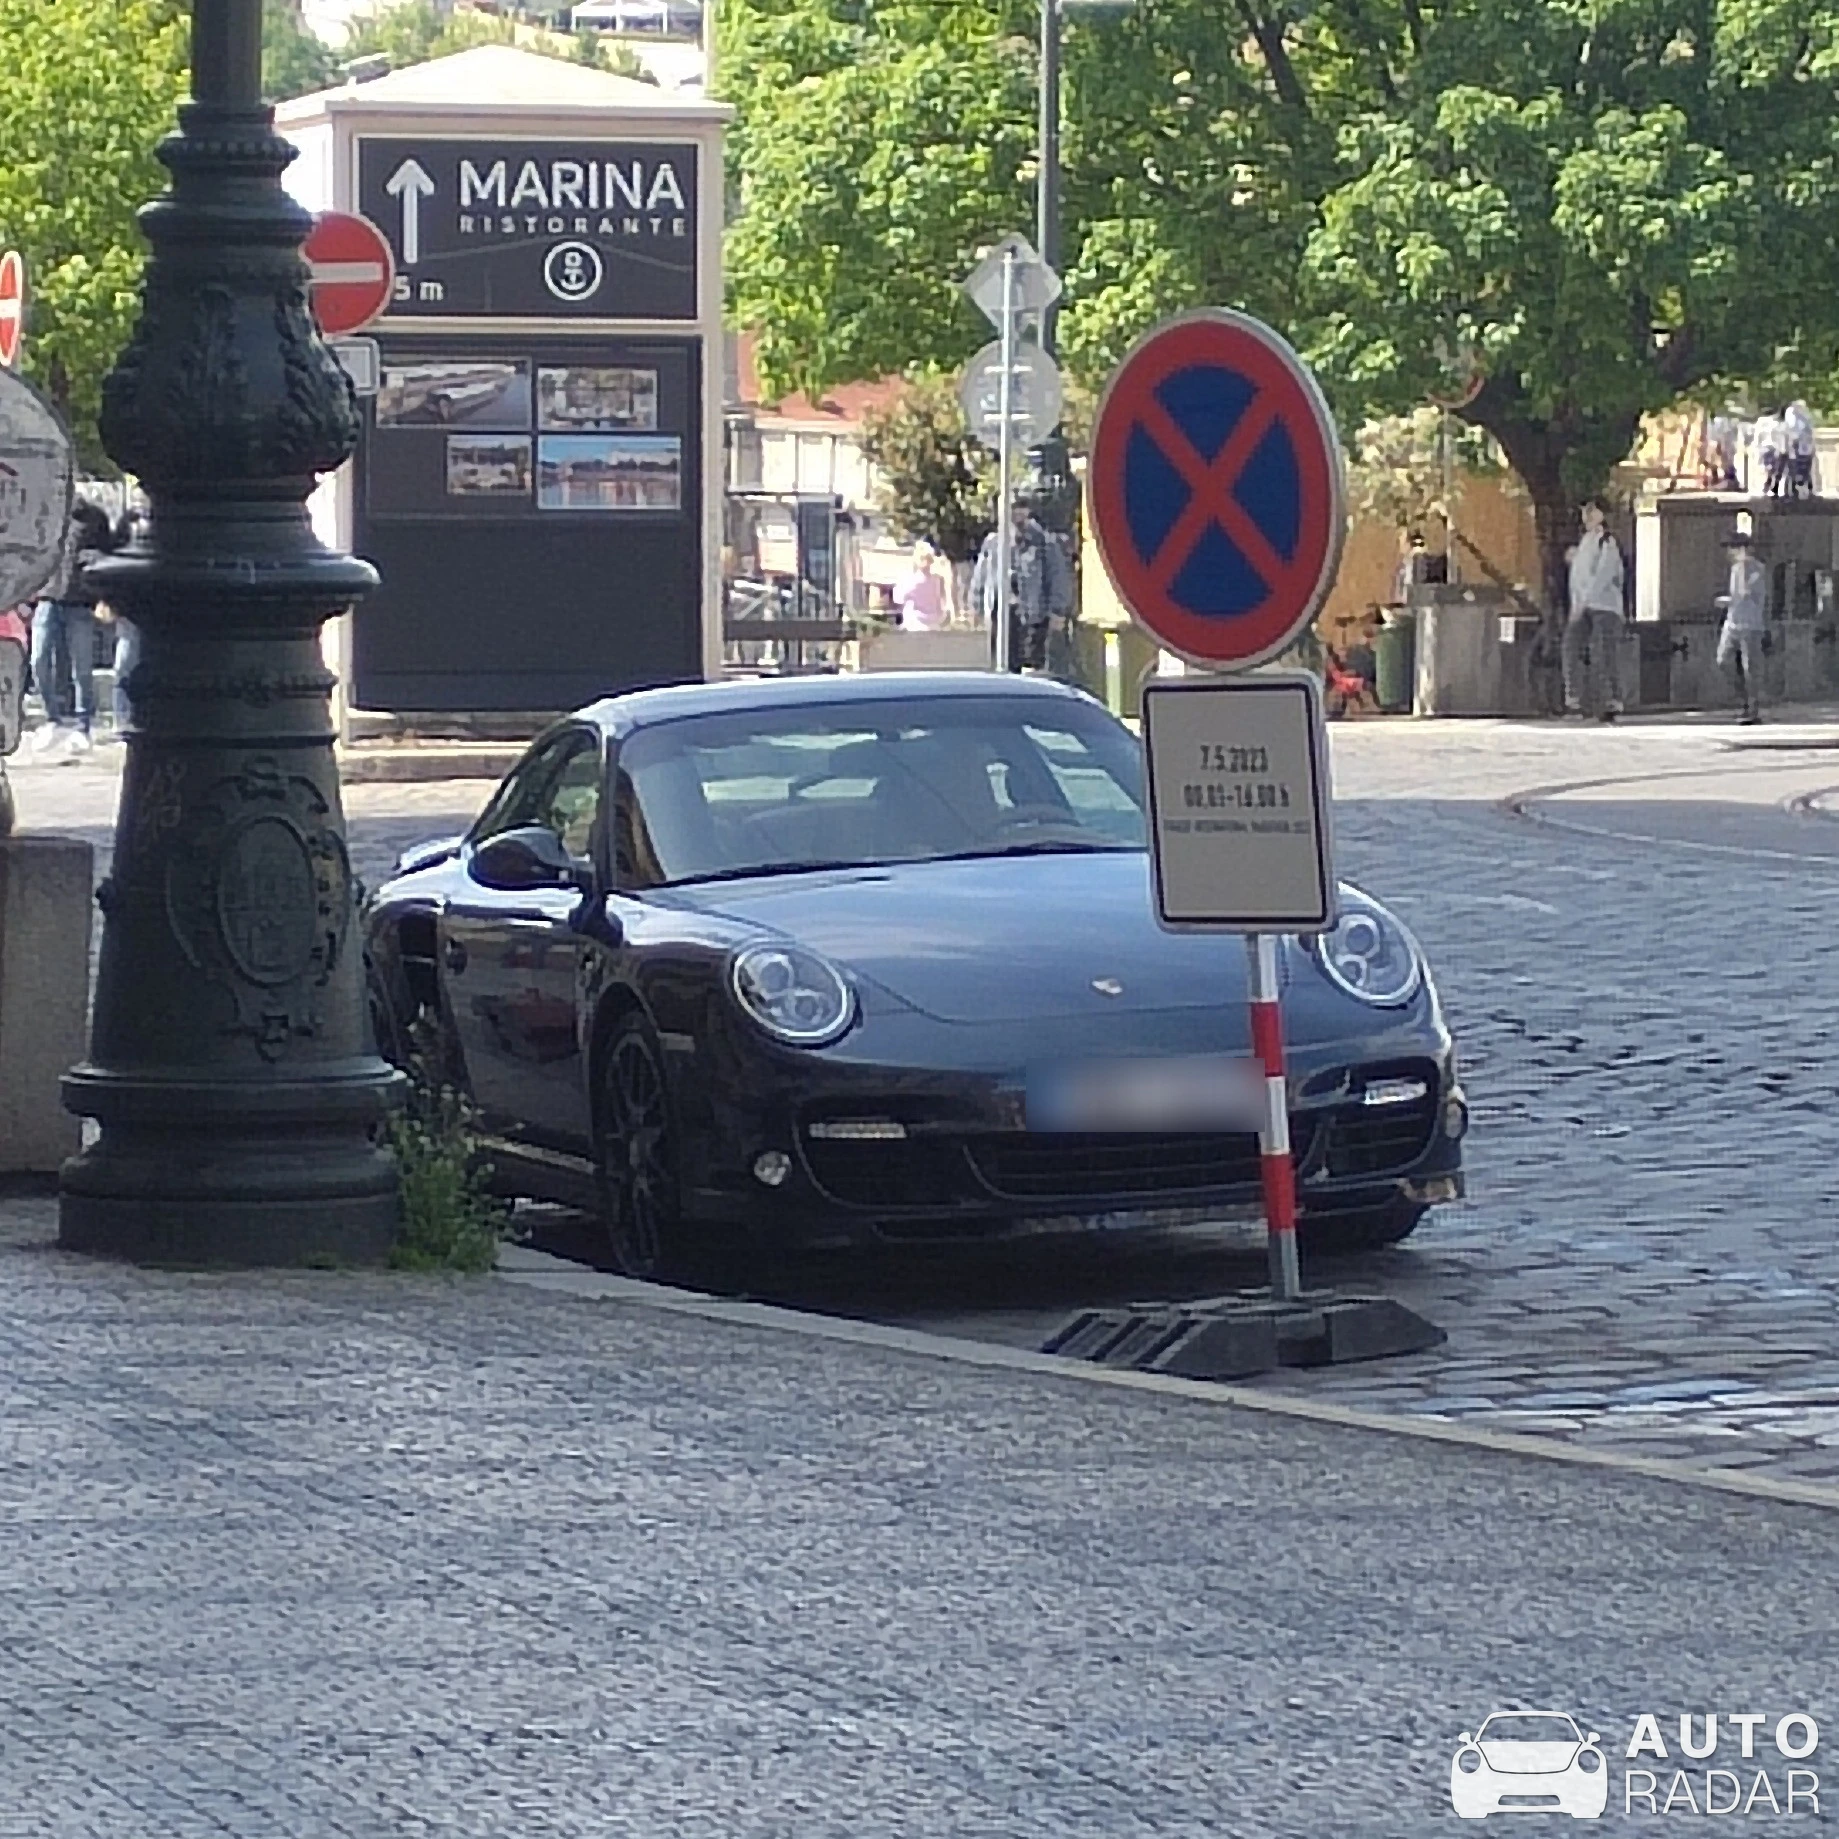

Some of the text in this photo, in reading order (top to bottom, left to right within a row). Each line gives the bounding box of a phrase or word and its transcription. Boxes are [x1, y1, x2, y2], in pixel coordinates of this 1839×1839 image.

[459, 159, 685, 210] MARINA
[459, 215, 687, 237] RISTORANTE
[419, 281, 444, 301] m
